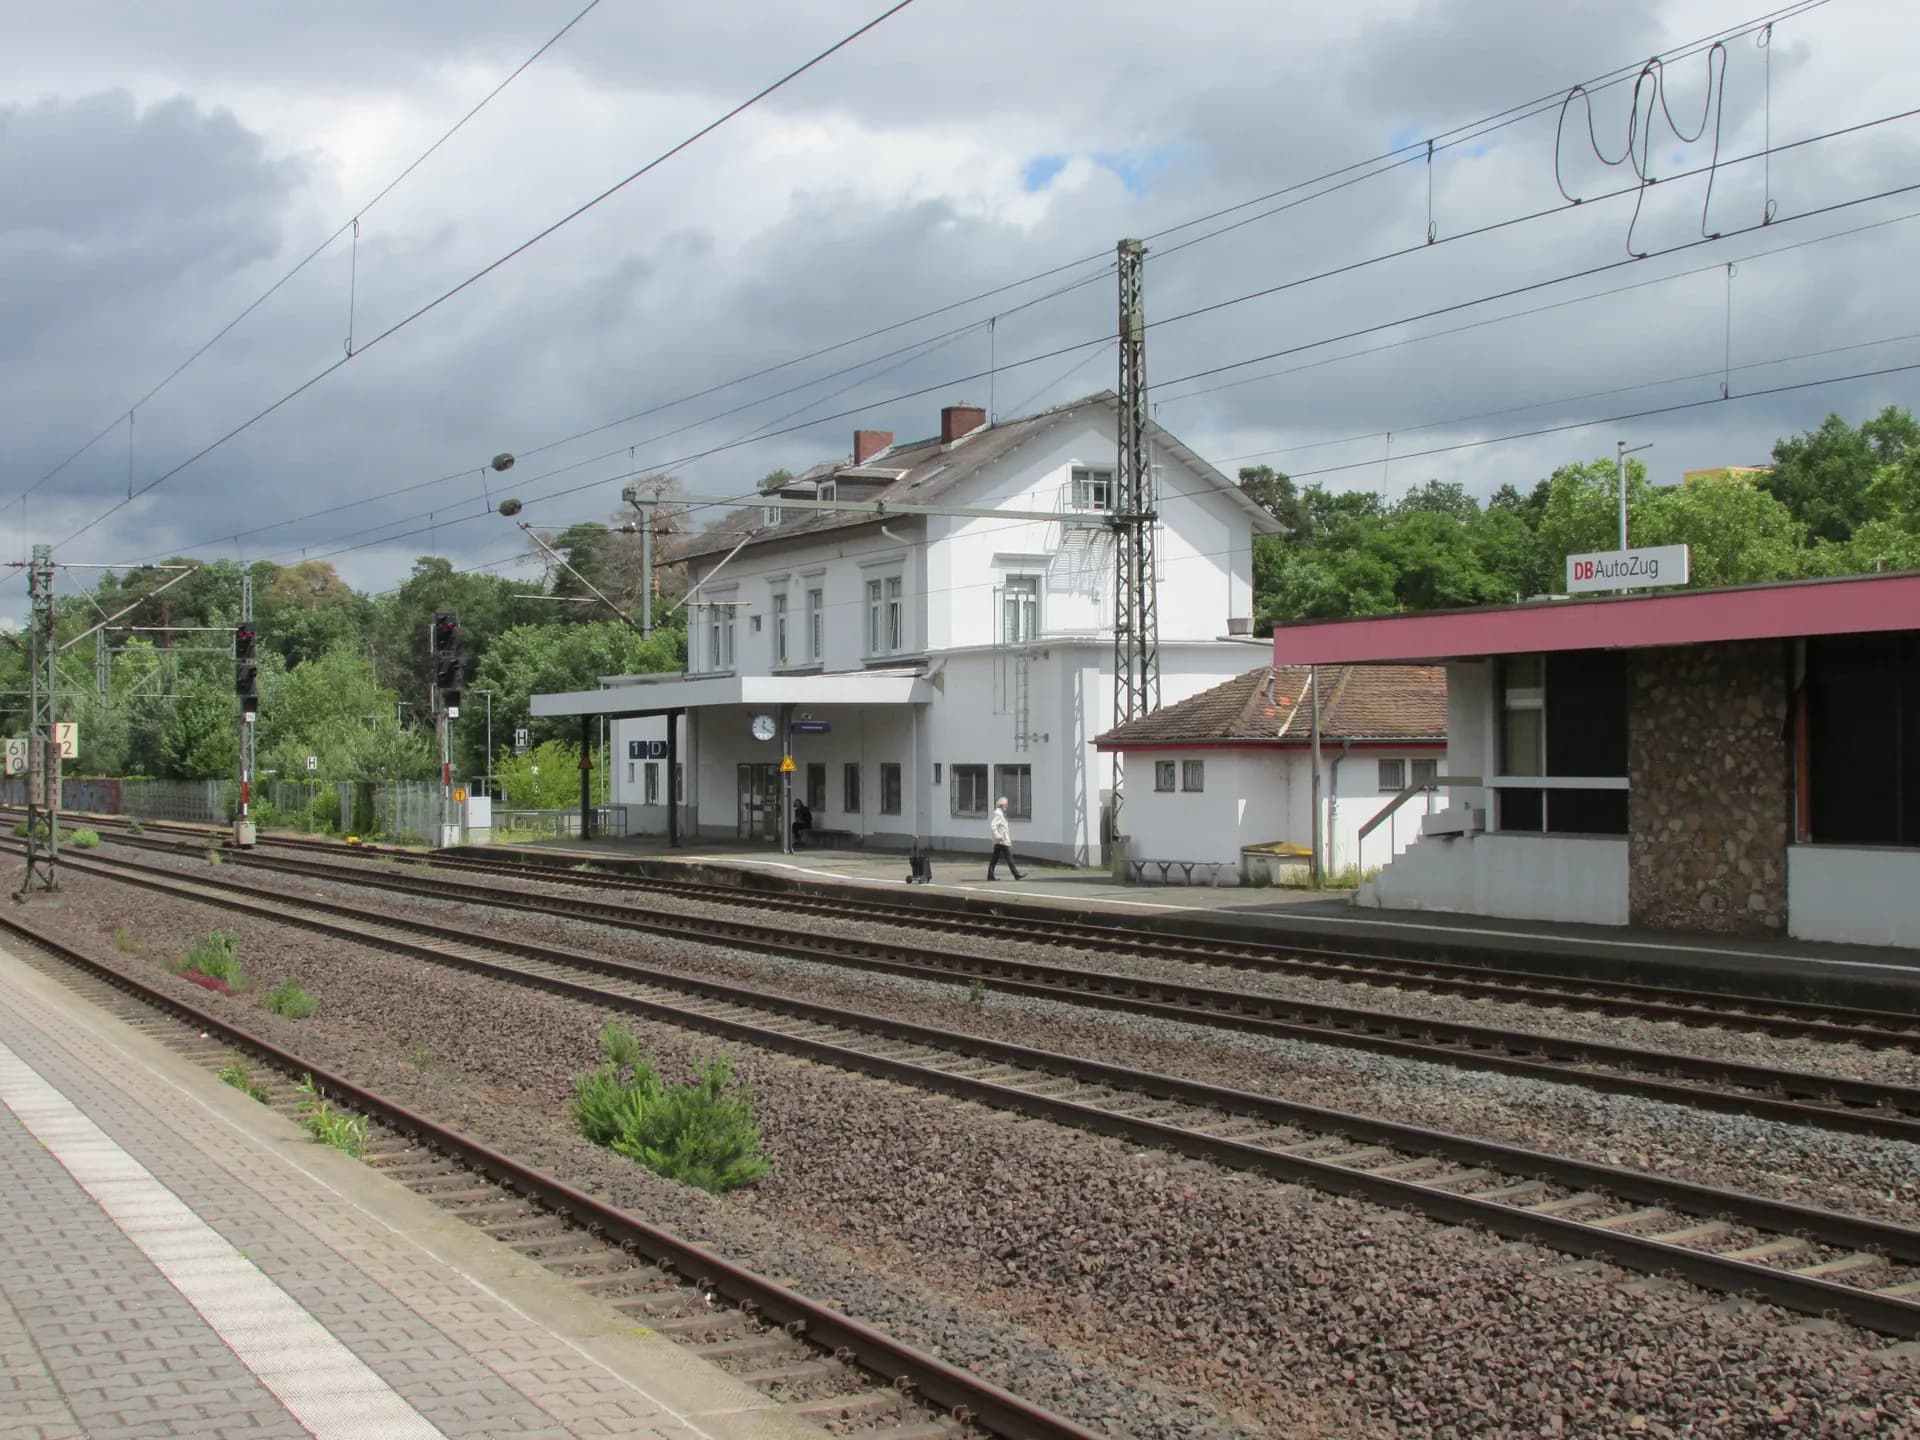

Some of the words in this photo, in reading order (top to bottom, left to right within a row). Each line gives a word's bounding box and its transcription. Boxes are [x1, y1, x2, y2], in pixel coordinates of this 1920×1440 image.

[62, 725, 72, 738] 7
[517, 730, 527, 745] H
[9, 741, 27, 756] 61
[63, 741, 73, 755] 2
[651, 742, 662, 756] D
